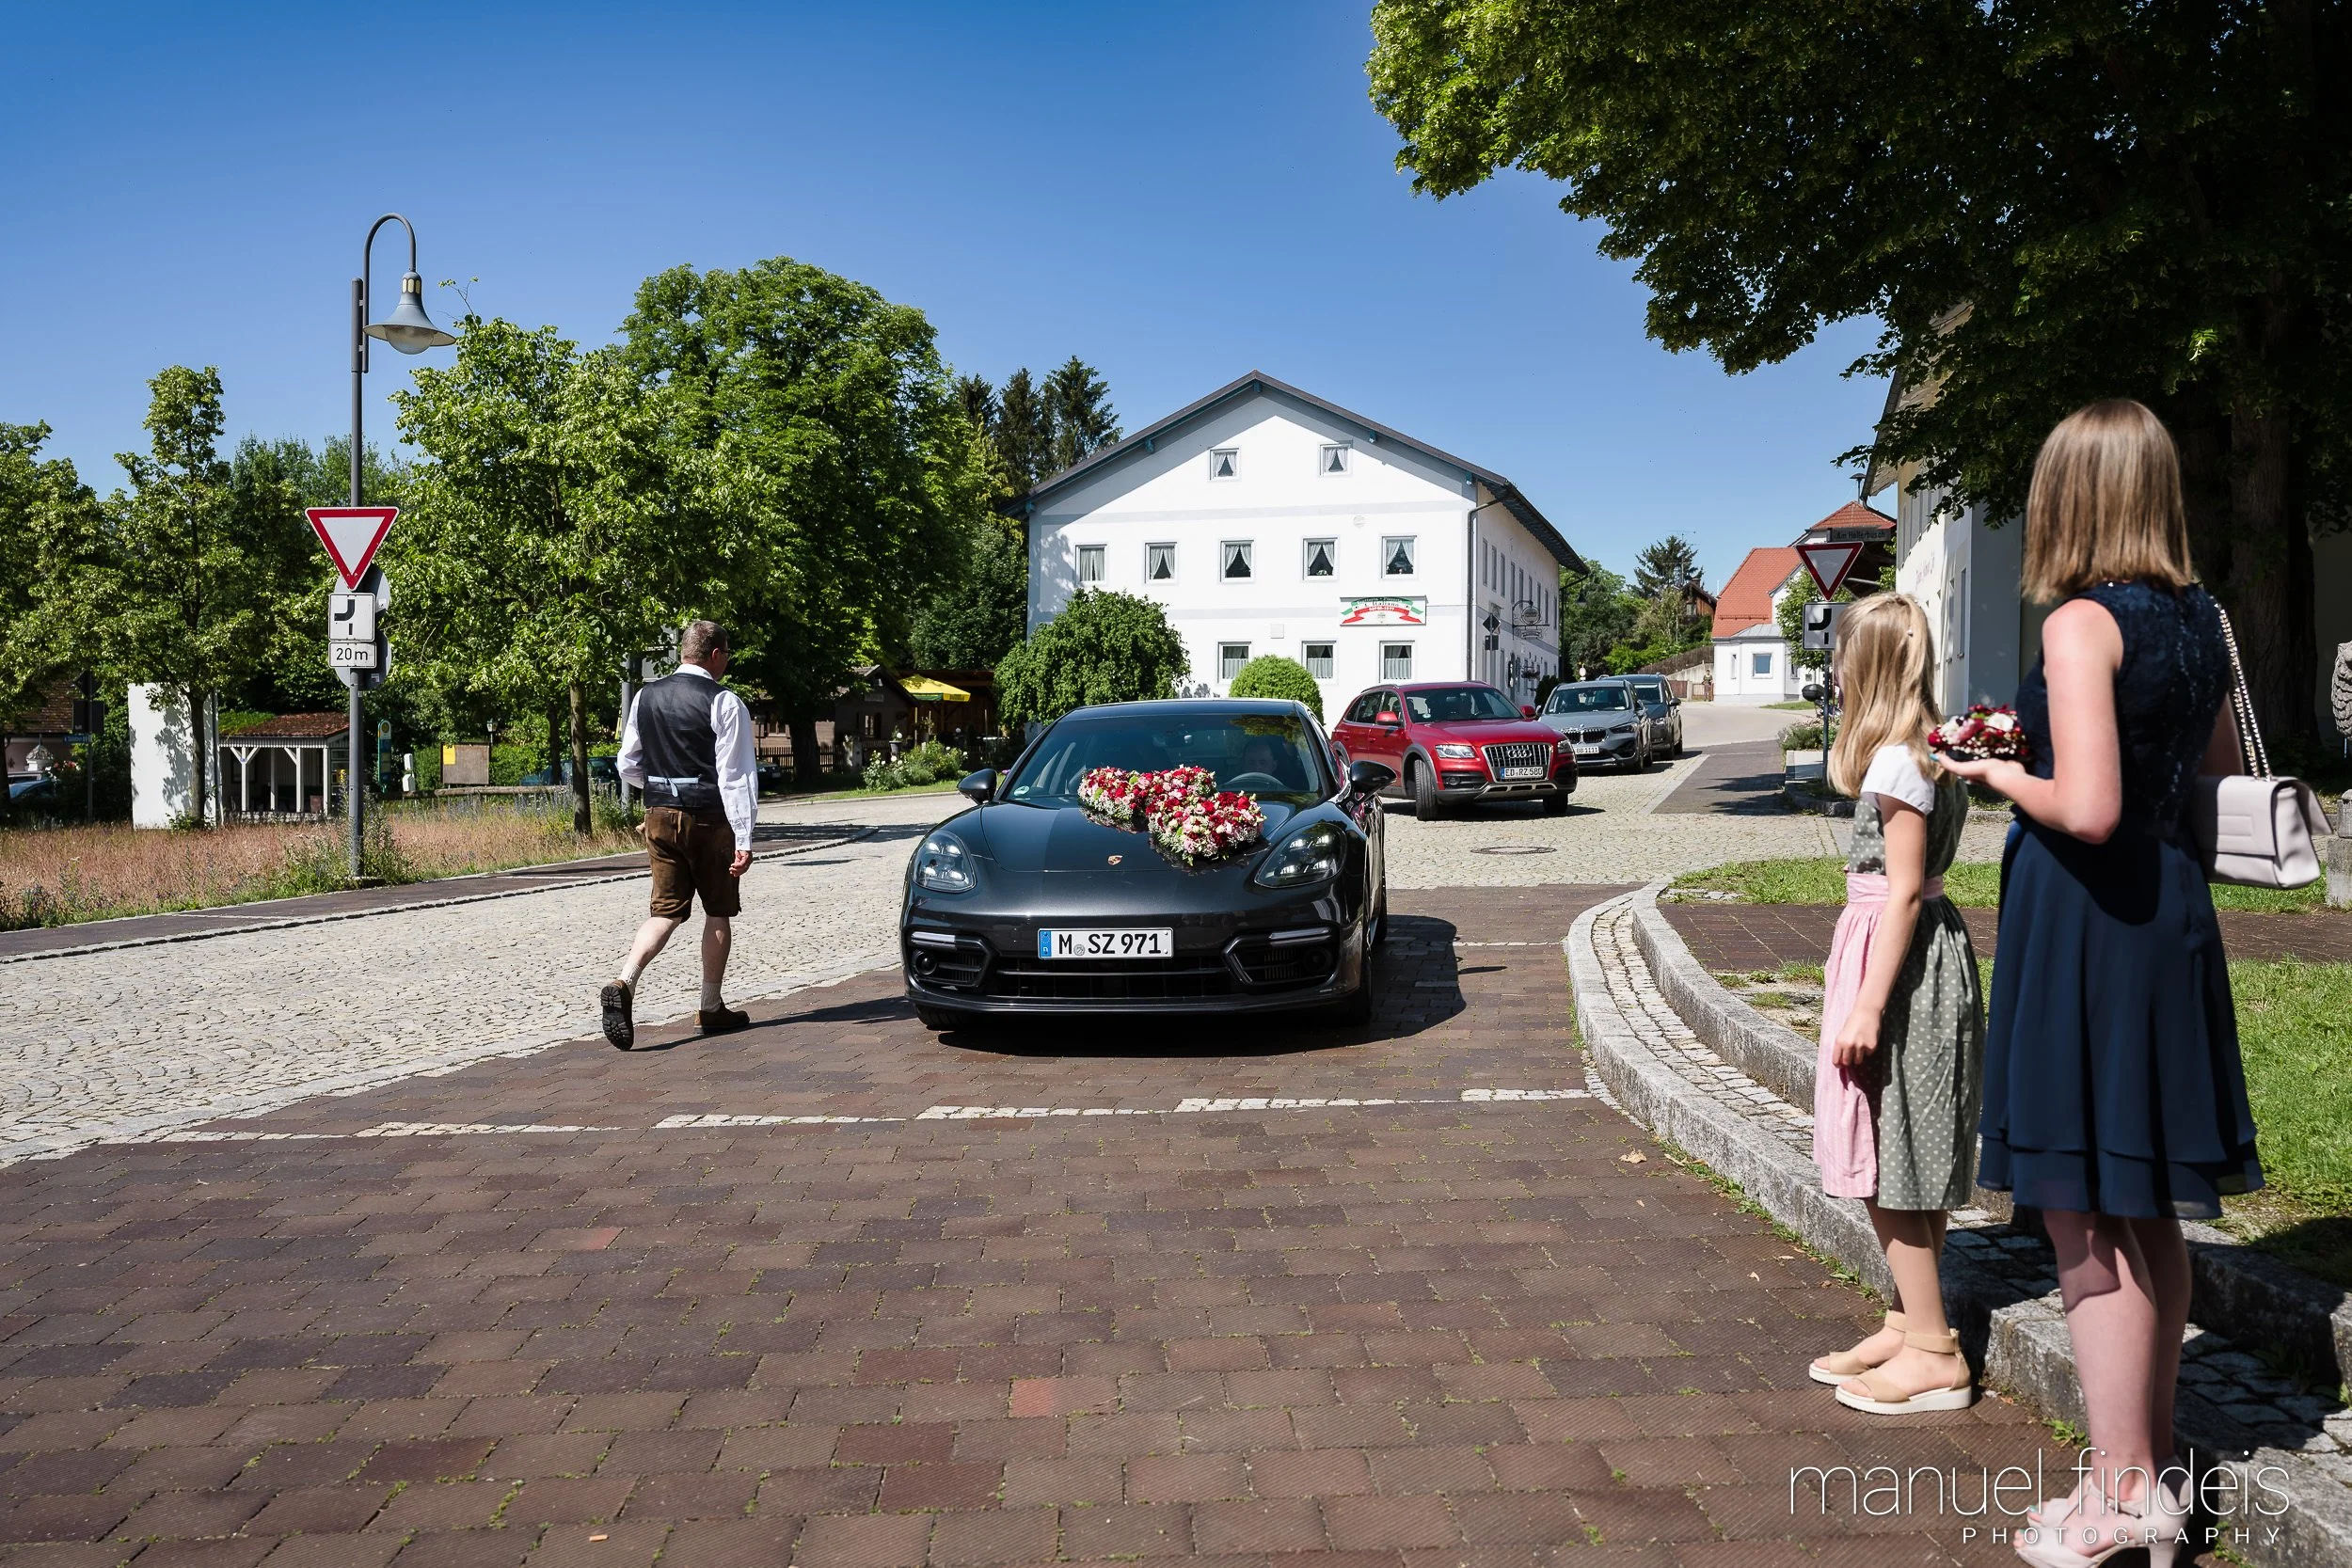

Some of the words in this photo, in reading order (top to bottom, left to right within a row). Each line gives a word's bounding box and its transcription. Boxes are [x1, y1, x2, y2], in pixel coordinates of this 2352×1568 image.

[1505, 768, 1515, 777] ED
[1518, 768, 1529, 776] RZ
[1058, 933, 1073, 955] M
[1088, 933, 1116, 955] SZ
[1120, 933, 1162, 955] 971
